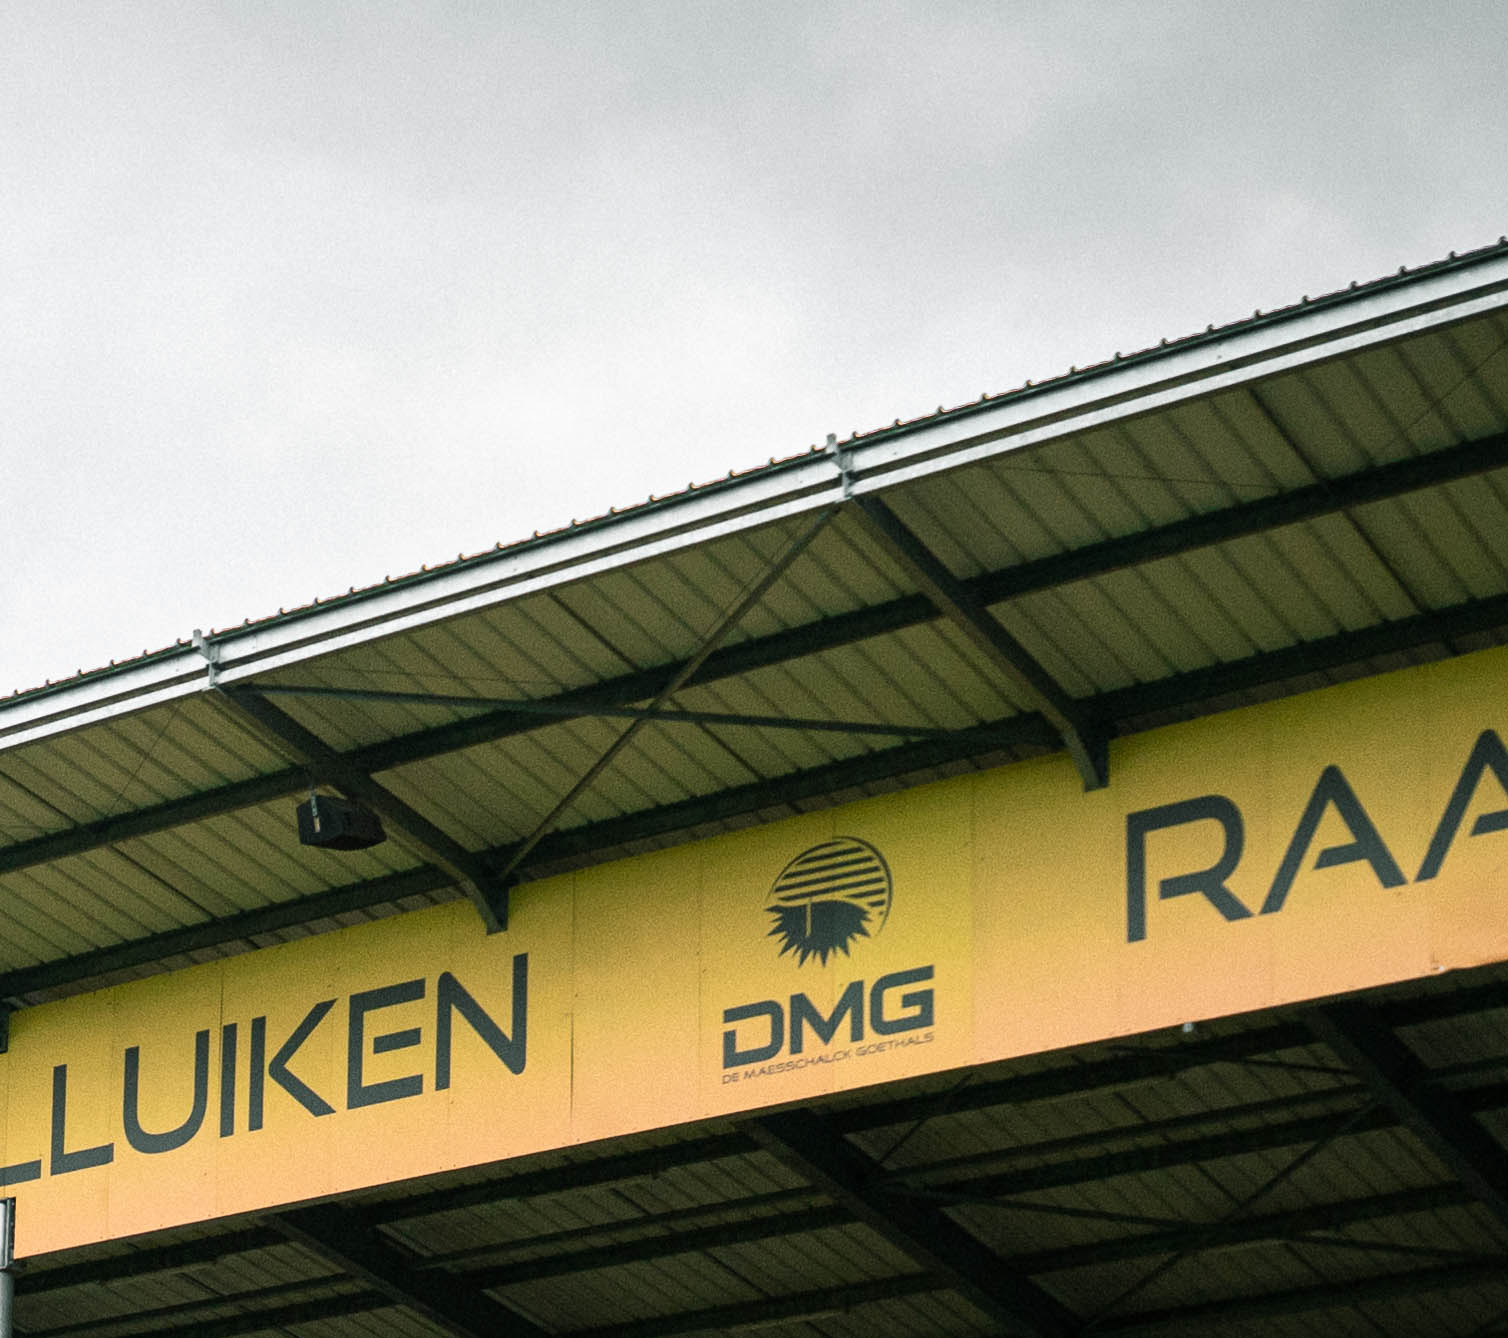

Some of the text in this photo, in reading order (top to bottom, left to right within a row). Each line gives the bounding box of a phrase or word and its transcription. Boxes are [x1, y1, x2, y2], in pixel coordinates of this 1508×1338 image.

[723, 965, 934, 1069] DMG
[722, 1073, 739, 1084] DE
[856, 1032, 934, 1056] GOETHALS
